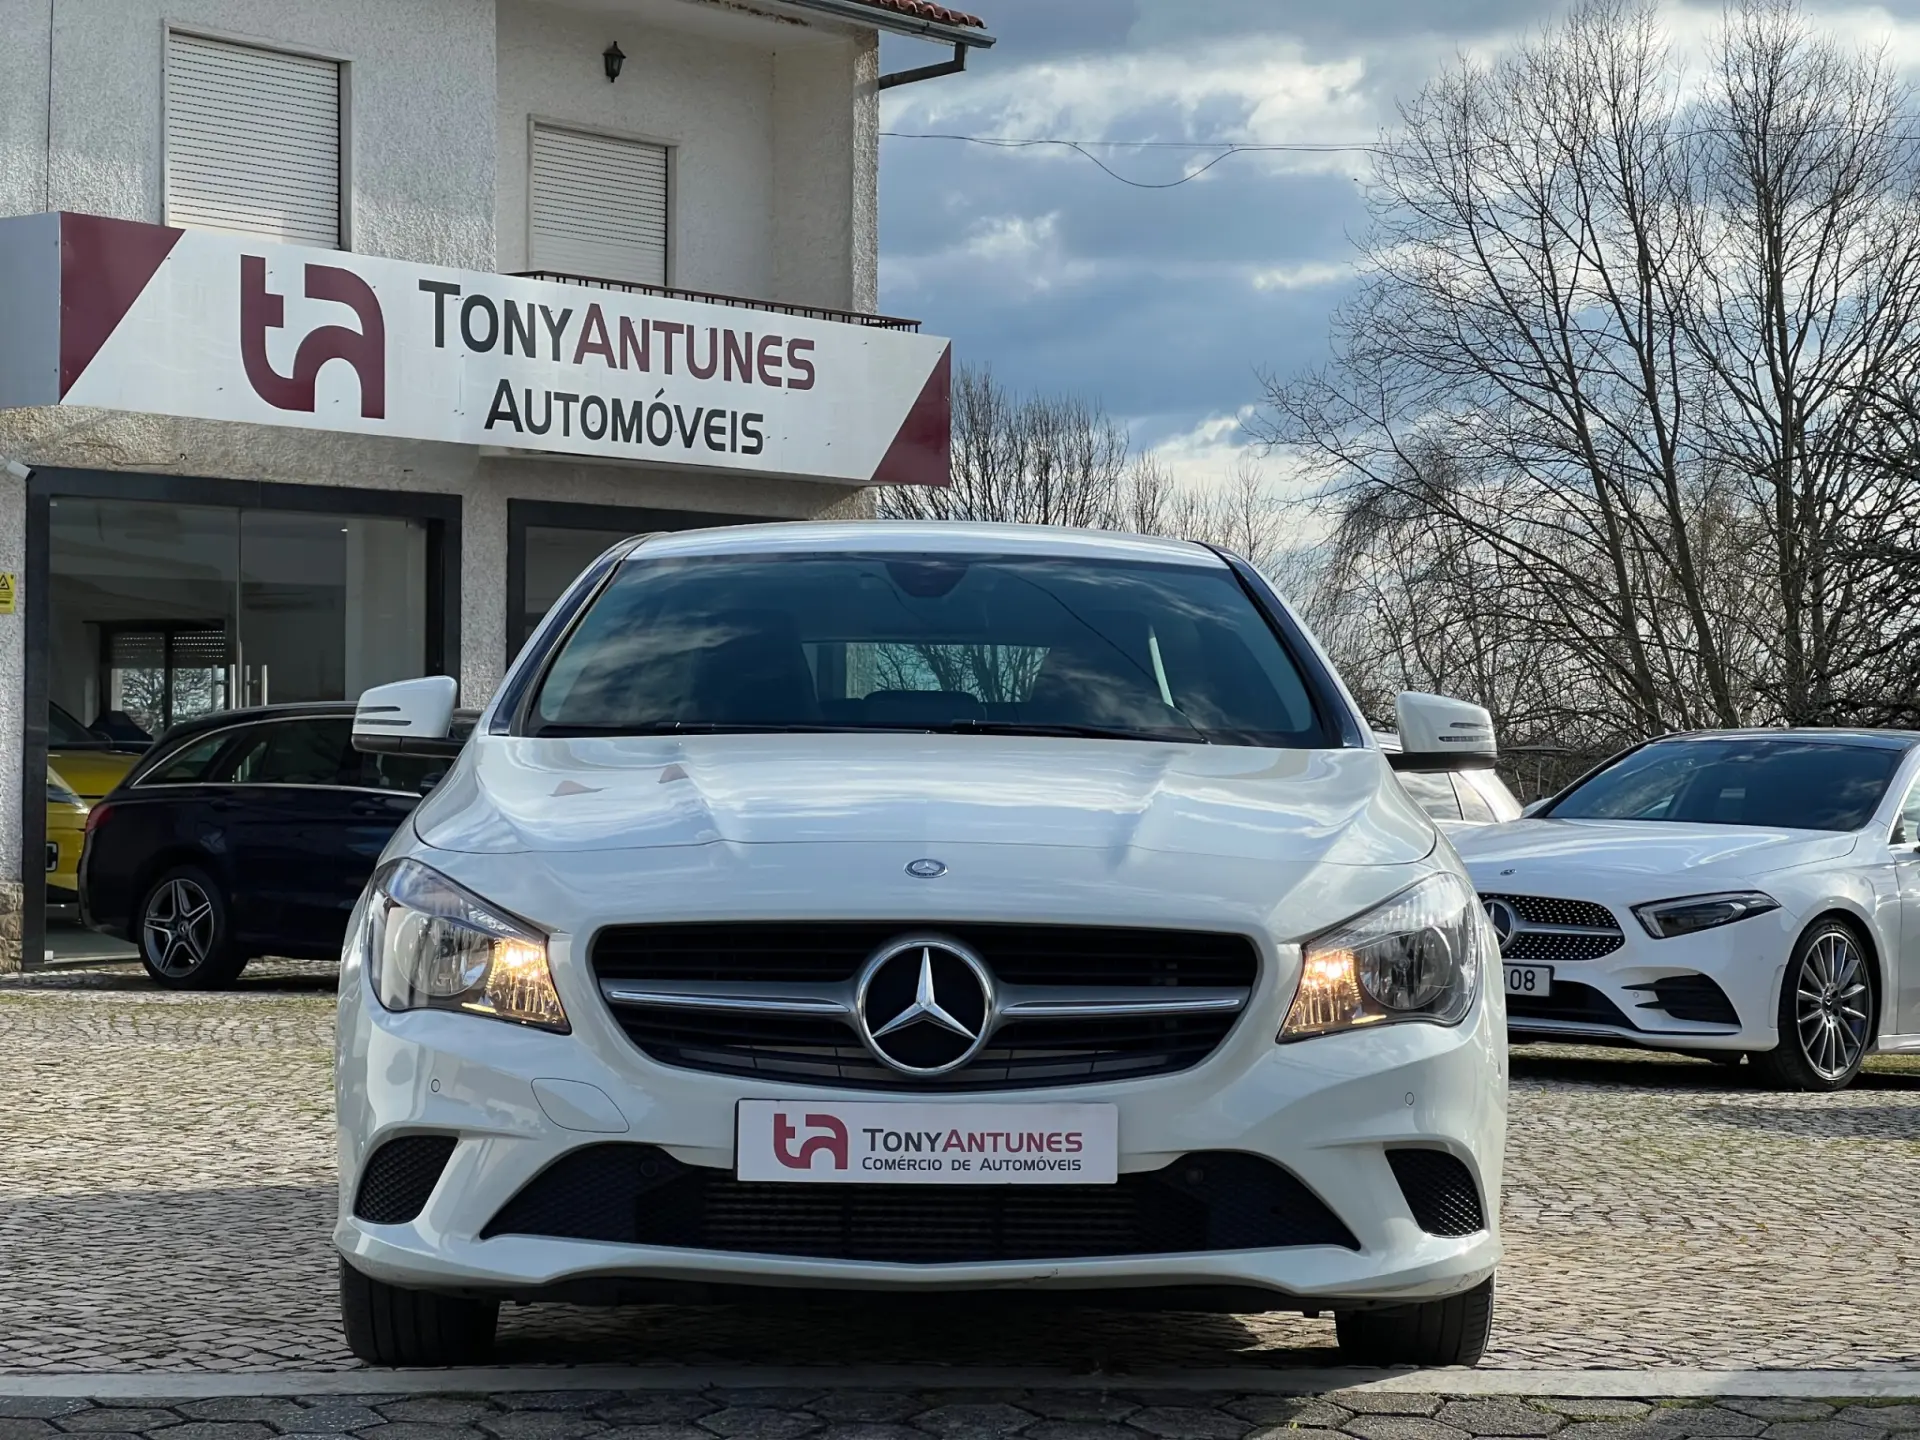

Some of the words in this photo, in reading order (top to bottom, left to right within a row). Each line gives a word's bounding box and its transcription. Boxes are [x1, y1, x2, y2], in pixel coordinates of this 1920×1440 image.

[484, 378, 765, 455] AUTOMÓVEIS
[862, 1155, 943, 1171] COMÉRCIO
[951, 1159, 971, 1171] DE
[979, 1155, 1082, 1171] AUTOMÓVEIS
